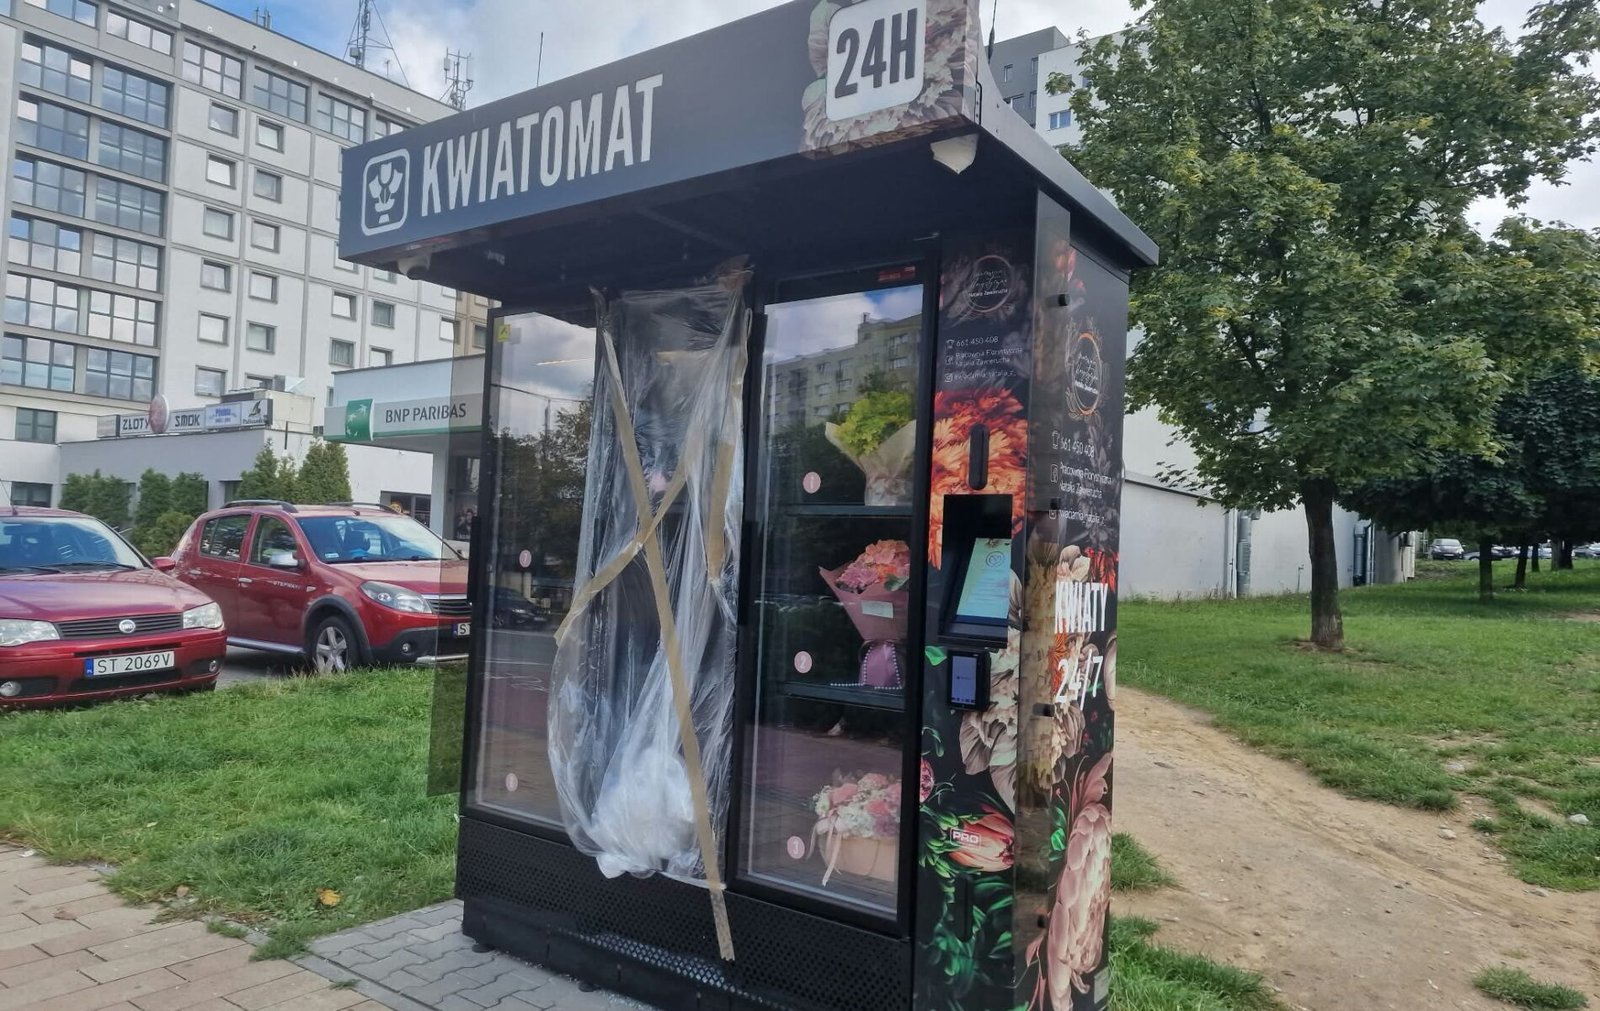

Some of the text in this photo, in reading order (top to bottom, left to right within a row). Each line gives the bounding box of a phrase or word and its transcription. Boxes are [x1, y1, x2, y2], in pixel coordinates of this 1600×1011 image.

[834, 8, 918, 99] 24H
[421, 73, 664, 217] KWIATOMAT
[174, 414, 201, 428] SMOK
[385, 403, 467, 423] BNP PARIBAS
[122, 417, 151, 431] ZŁOTY
[1055, 581, 1108, 633] KWIATY
[97, 653, 171, 674] ST 2069V
[1055, 649, 1104, 711] 24/7
[952, 831, 979, 844] PRO
